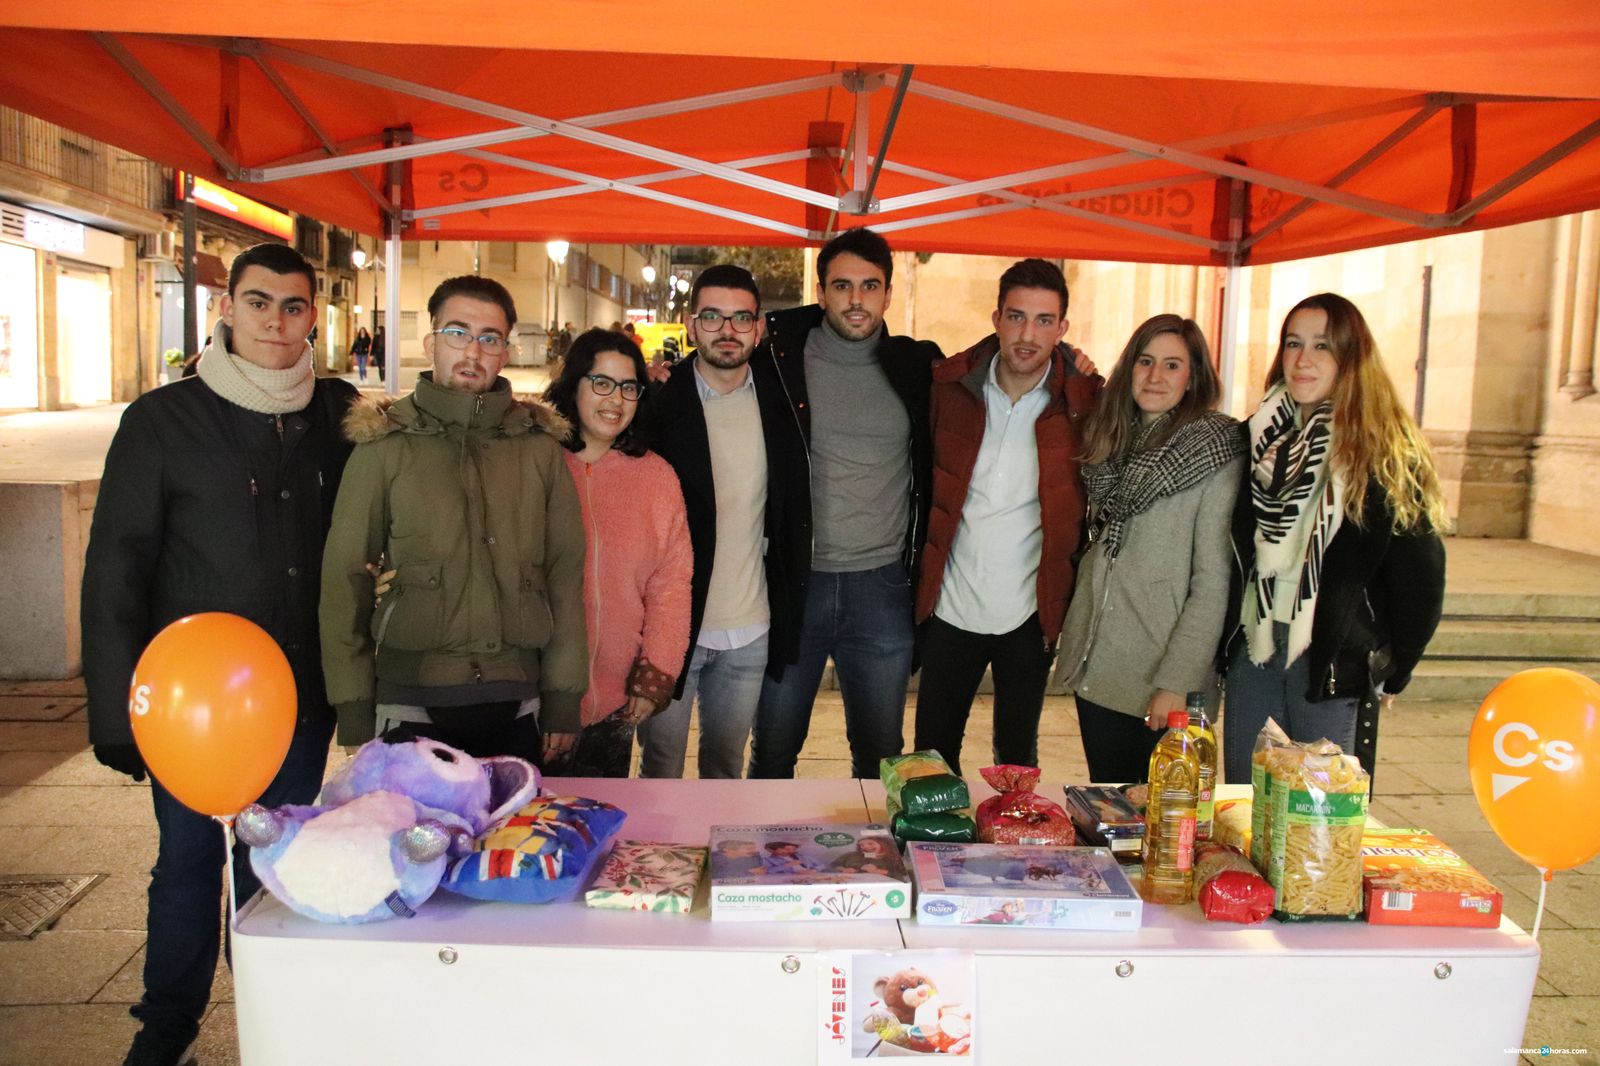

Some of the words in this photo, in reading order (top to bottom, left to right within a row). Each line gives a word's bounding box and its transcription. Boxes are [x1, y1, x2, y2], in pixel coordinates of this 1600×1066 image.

[1493, 722, 1575, 772] Cs
[717, 893, 745, 903] Caza
[748, 892, 802, 903] mostacho
[927, 905, 953, 913] FROZEN
[825, 966, 847, 1045] JÓVENES
